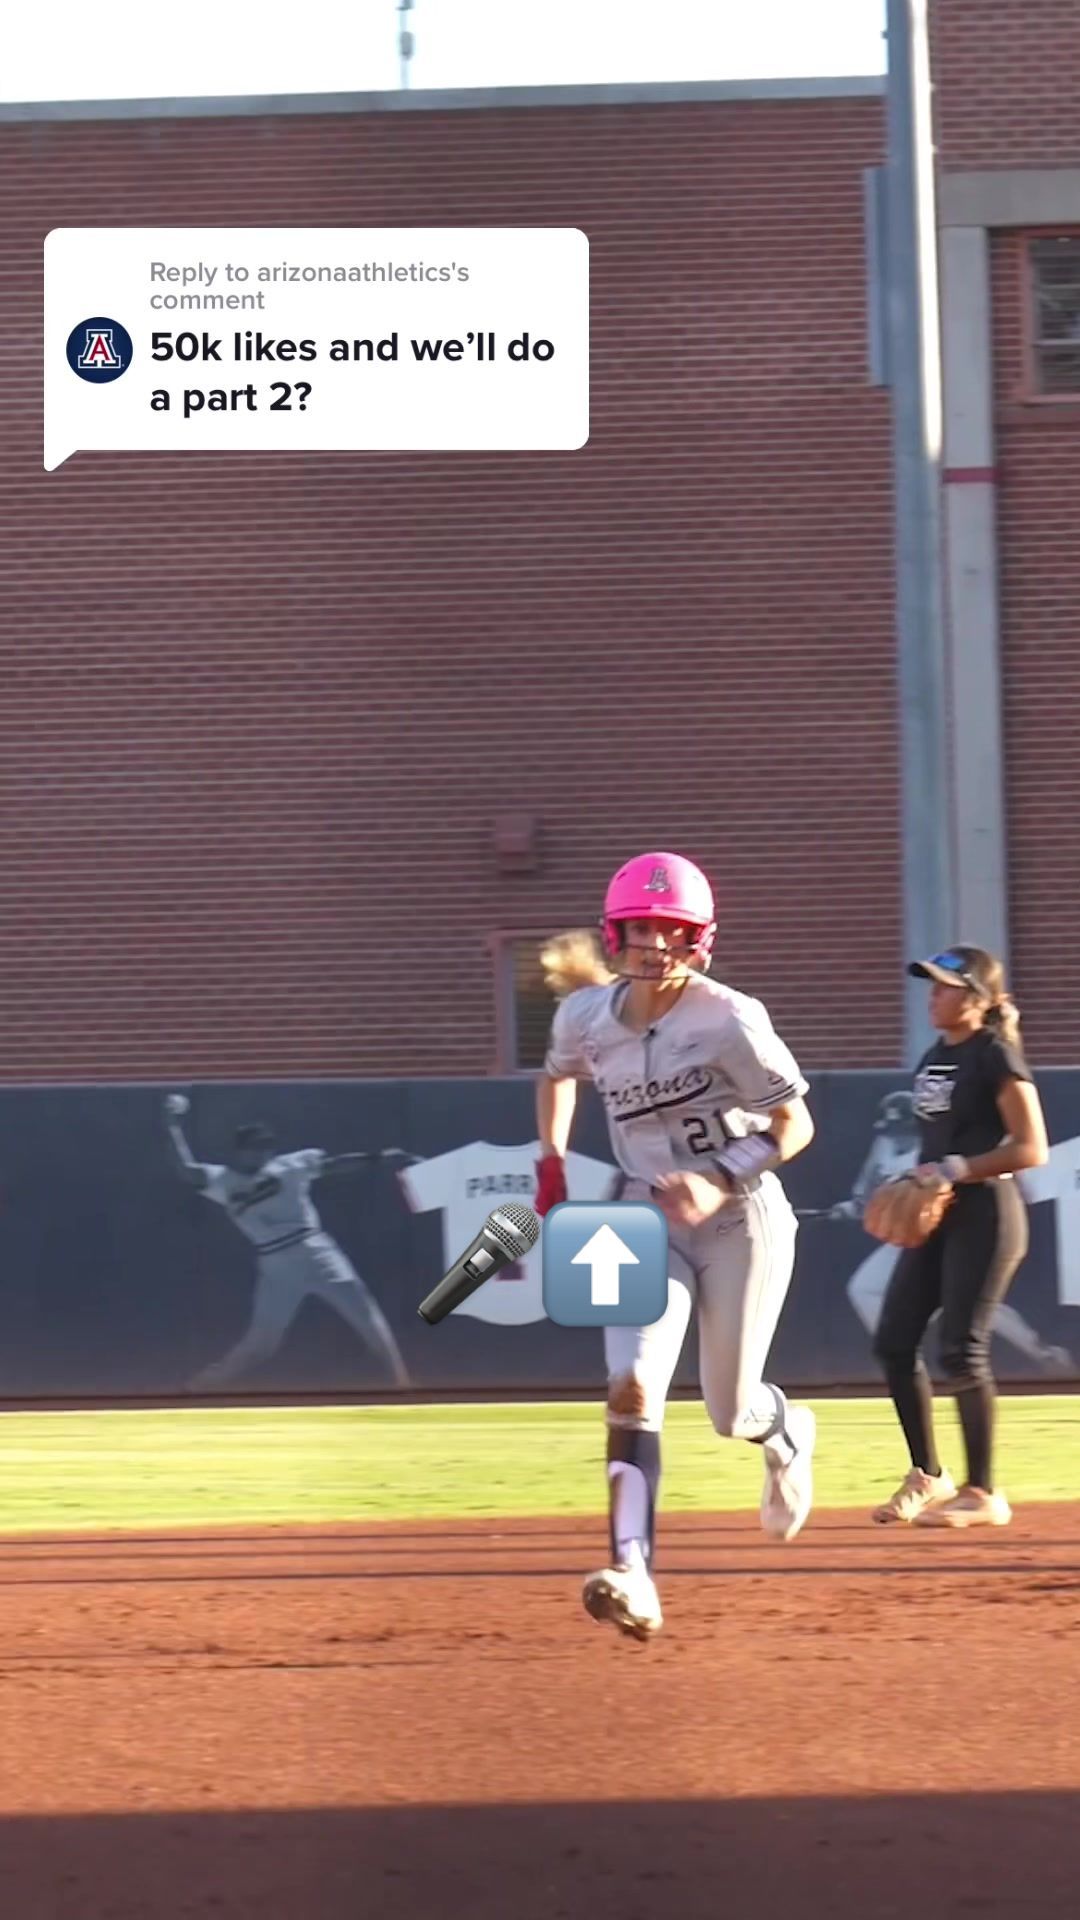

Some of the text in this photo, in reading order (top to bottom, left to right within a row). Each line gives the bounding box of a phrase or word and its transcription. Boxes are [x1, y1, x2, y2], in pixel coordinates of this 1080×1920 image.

[598, 1066, 708, 1108] rizona
[683, 1108, 728, 1156] 21
[465, 1173, 535, 1198] PARR
